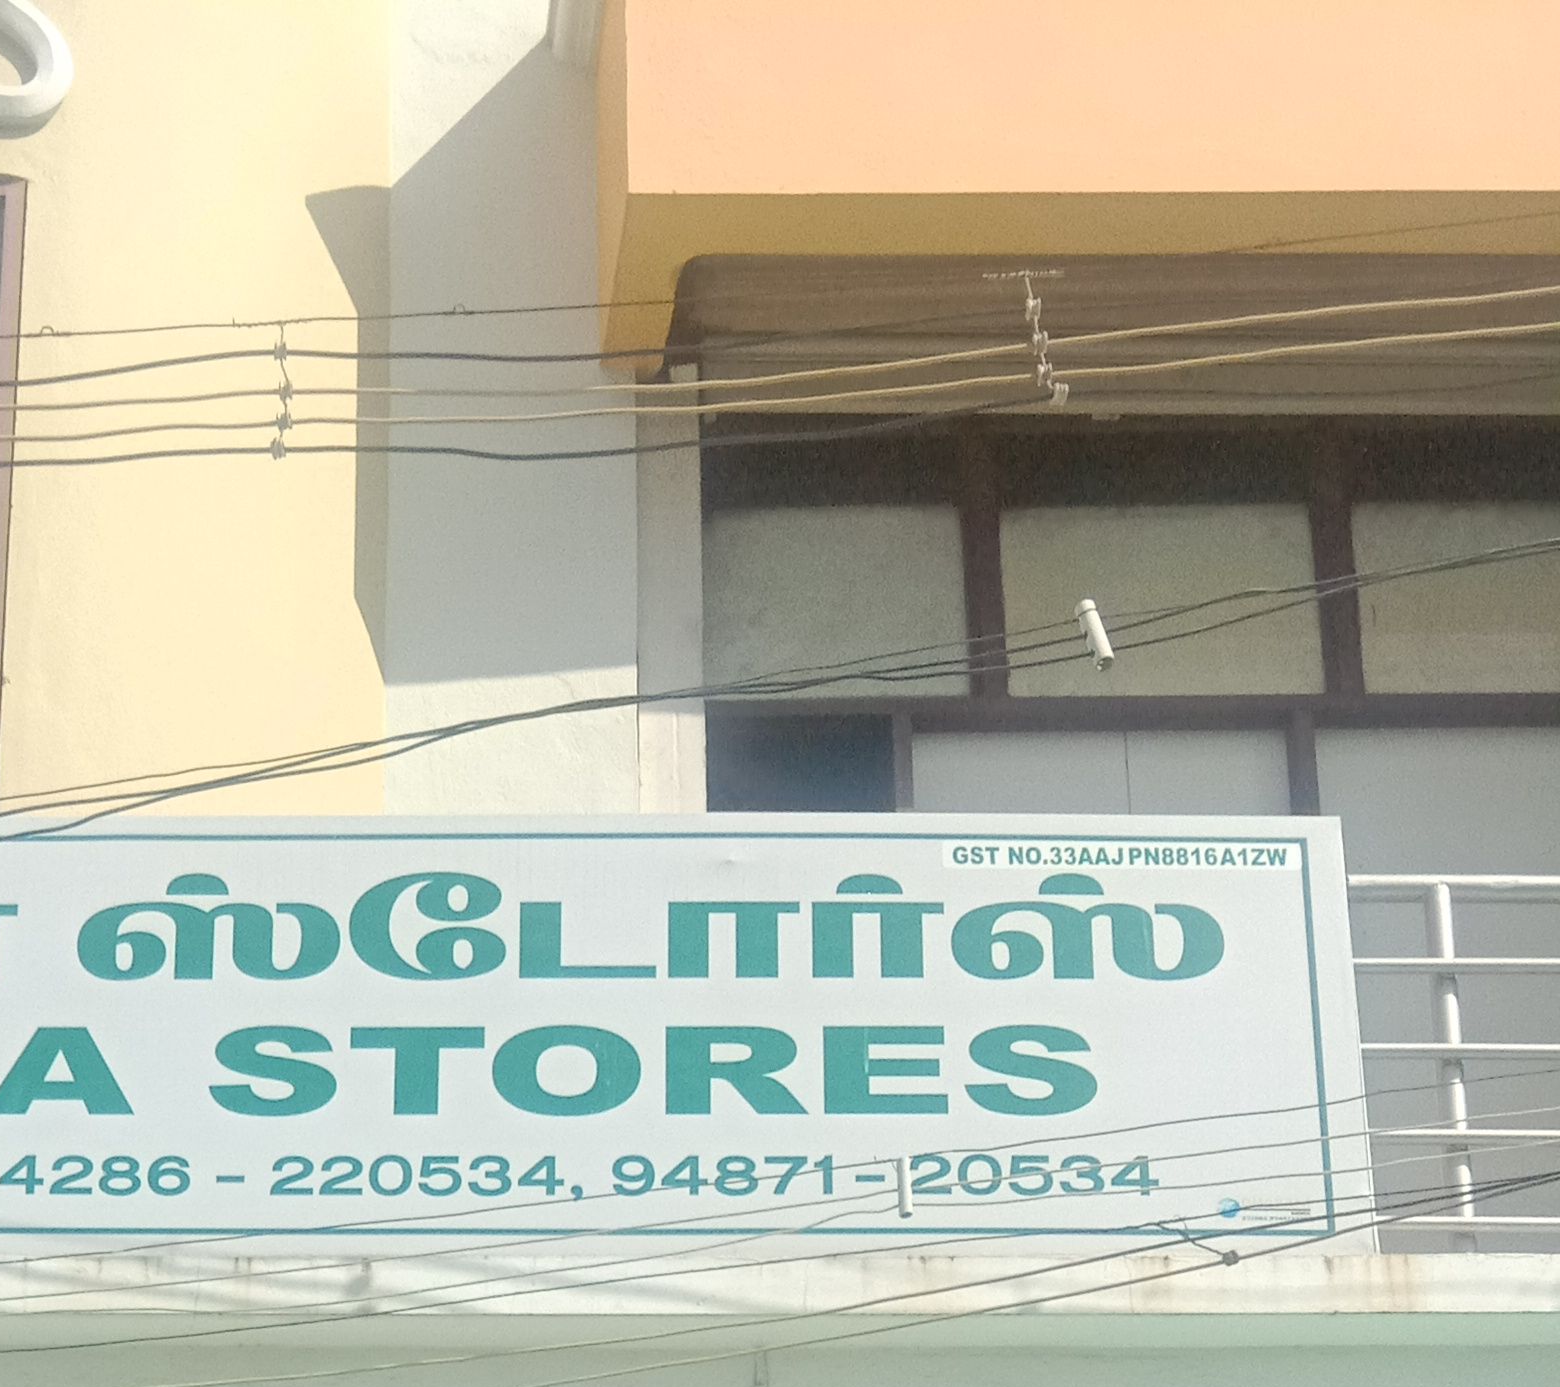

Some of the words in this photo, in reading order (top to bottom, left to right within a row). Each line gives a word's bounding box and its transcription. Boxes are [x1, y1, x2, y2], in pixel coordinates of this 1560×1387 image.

[952, 847, 999, 865] GST
[77, 872, 1225, 982] ஸ்டோர்ஸ்
[209, 1024, 1099, 1118] STORES
[270, 1154, 585, 1201] 220534,
